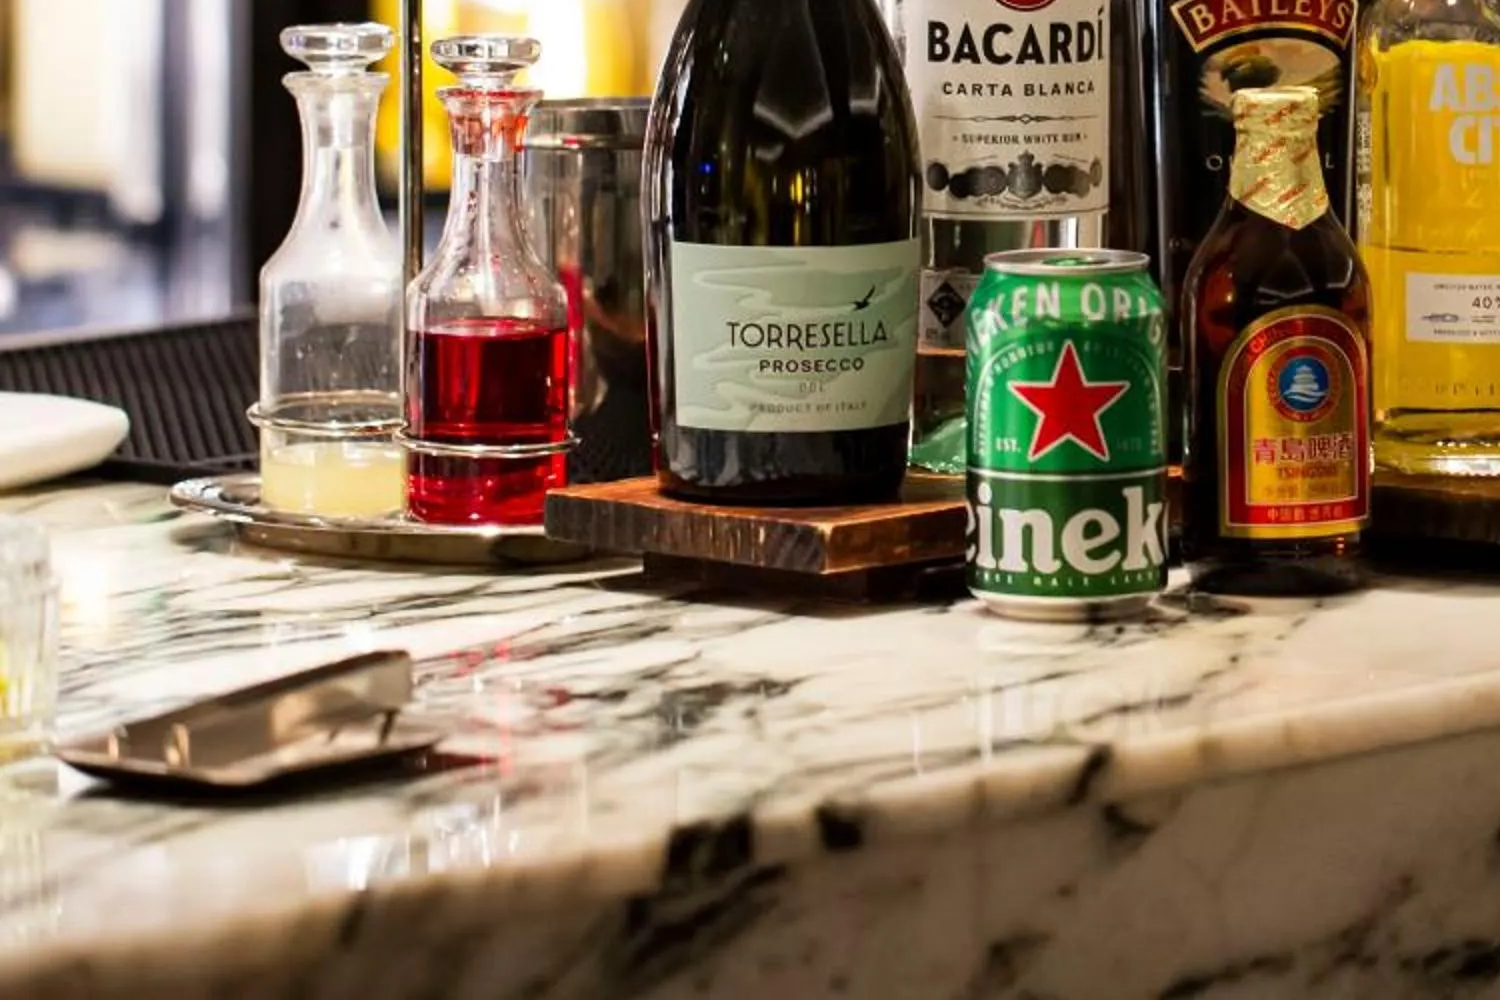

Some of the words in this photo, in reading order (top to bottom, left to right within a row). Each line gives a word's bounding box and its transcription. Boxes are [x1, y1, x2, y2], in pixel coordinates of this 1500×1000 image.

[928, 6, 1104, 65] BACARDÍ
[942, 81, 1014, 97] CARTA
[1023, 80, 1096, 97] BLANCA
[960, 133, 1020, 145] SUPERIOR
[1023, 133, 1059, 145] WHITE
[725, 320, 888, 351] TORRESELLA
[758, 356, 865, 374] PROSECCO
[966, 481, 1169, 575] inek
